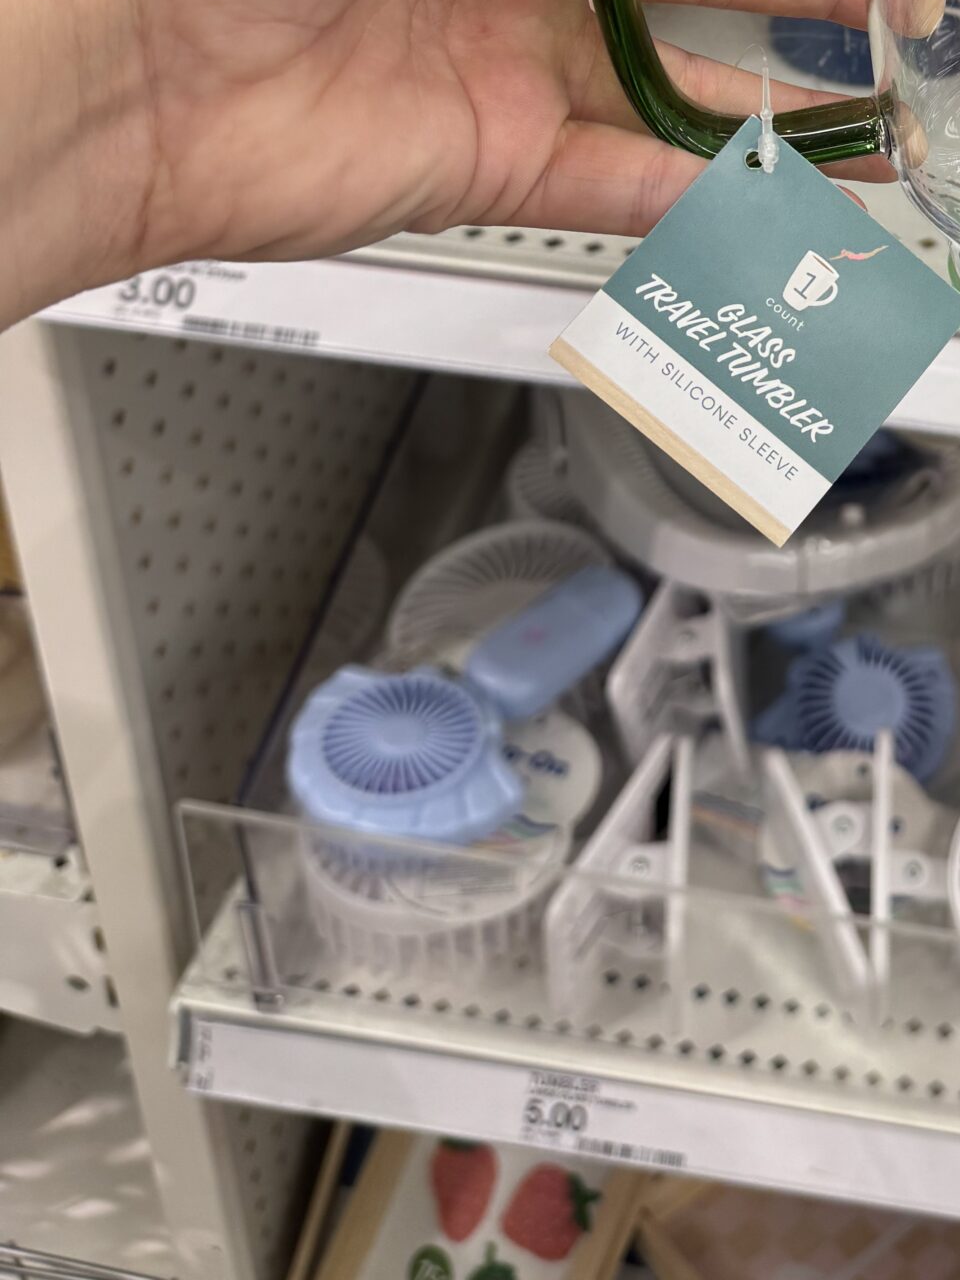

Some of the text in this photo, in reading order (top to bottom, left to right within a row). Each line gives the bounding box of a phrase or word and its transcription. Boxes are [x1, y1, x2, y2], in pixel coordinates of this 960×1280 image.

[793, 272, 817, 300] 1
[717, 303, 796, 368] GLASS
[765, 297, 804, 332] count
[635, 273, 834, 443] TRAVEL TUMBLER
[615, 321, 799, 481] WITH SILICONE SLEEVE
[523, 1097, 589, 1132] 5.00
